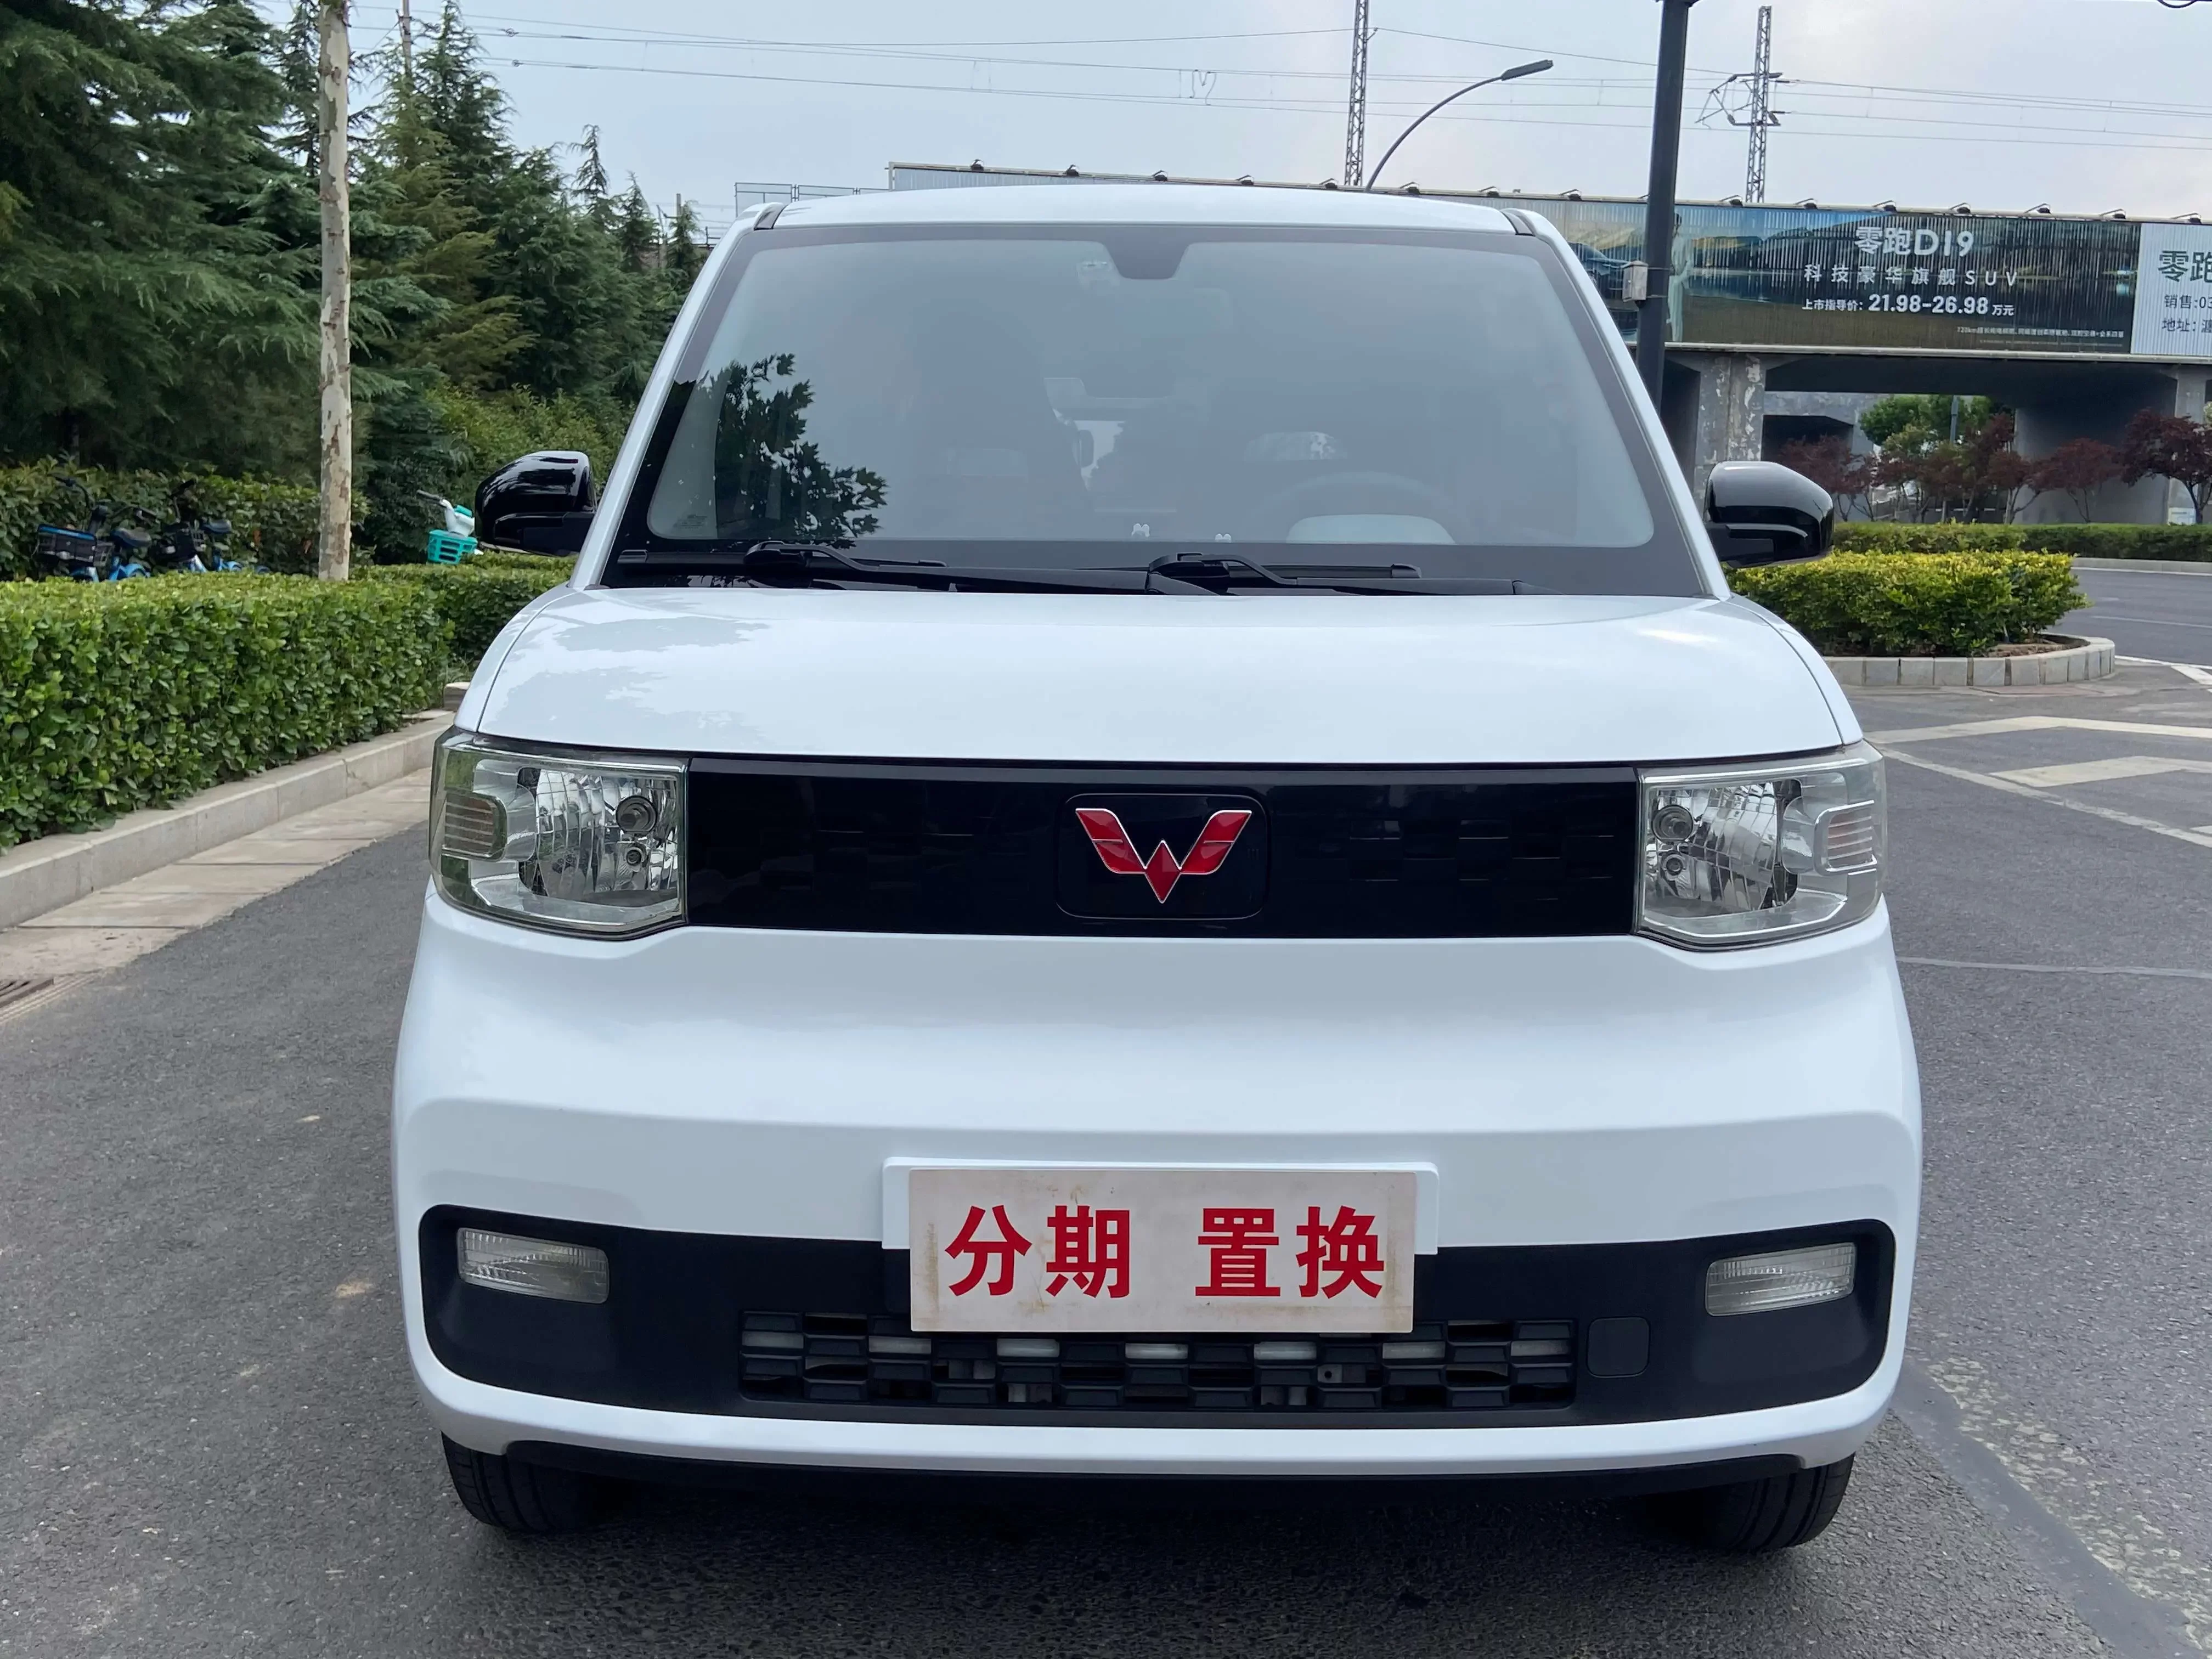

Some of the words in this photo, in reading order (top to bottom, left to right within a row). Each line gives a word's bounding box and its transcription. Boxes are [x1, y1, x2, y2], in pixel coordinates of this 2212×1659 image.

[1854, 226, 1974, 257] 零跑D19
[2158, 250, 2212, 283] 零跑
[1868, 294, 1989, 315] 21.98-26.98
[945, 1204, 1130, 1299] 分期
[1194, 1205, 1386, 1299] 置换
